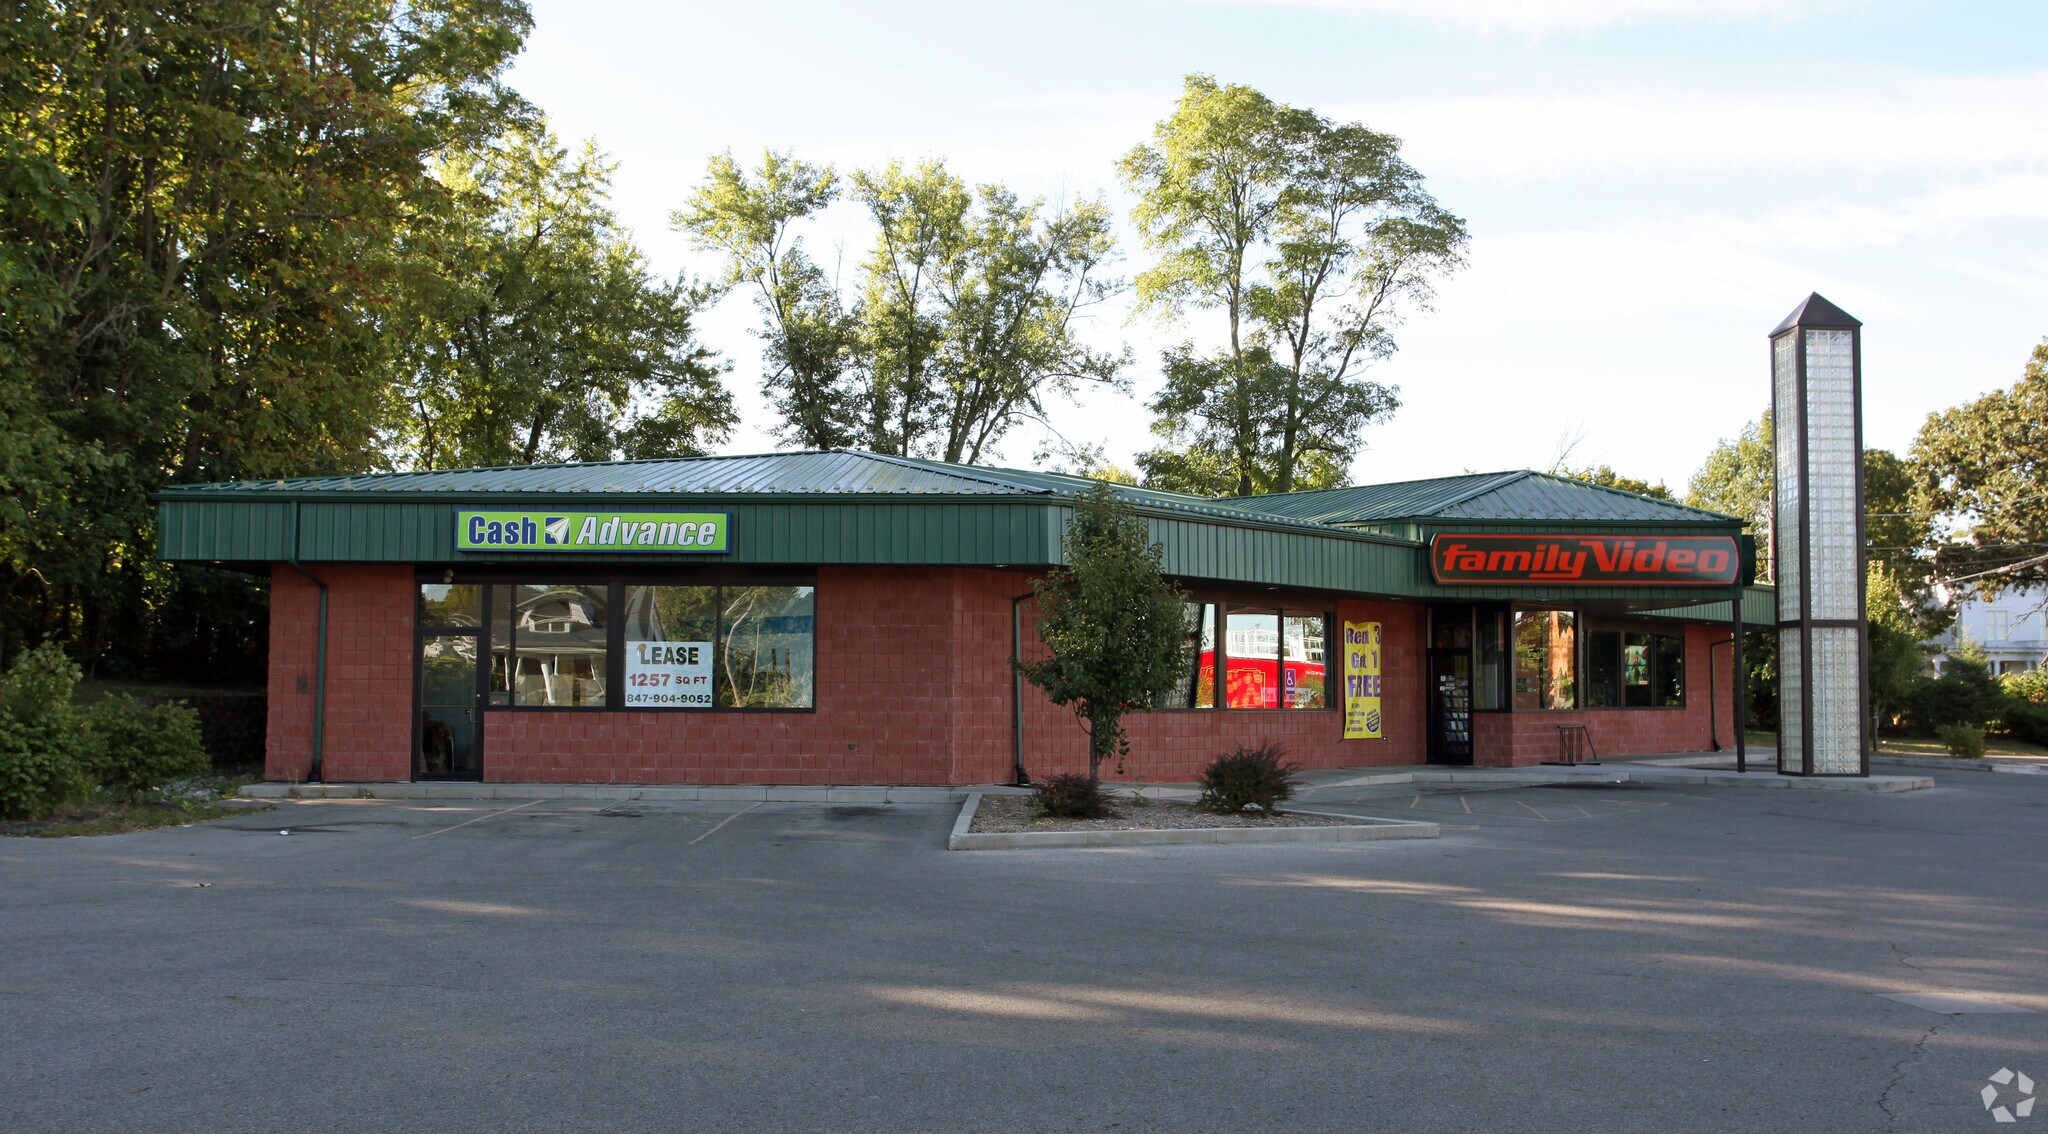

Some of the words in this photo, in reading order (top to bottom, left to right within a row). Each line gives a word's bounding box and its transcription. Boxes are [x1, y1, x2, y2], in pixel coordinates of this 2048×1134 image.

[468, 516, 537, 545] Cash
[576, 516, 717, 546] Advance
[1374, 625, 1381, 644] 3
[641, 647, 699, 665] LEASE
[1371, 650, 1377, 668] 1
[629, 673, 671, 686] 1257
[675, 676, 690, 685] SQ
[693, 676, 707, 685] FT
[1348, 675, 1381, 697] FREE
[626, 694, 711, 704] 847-904-9052
